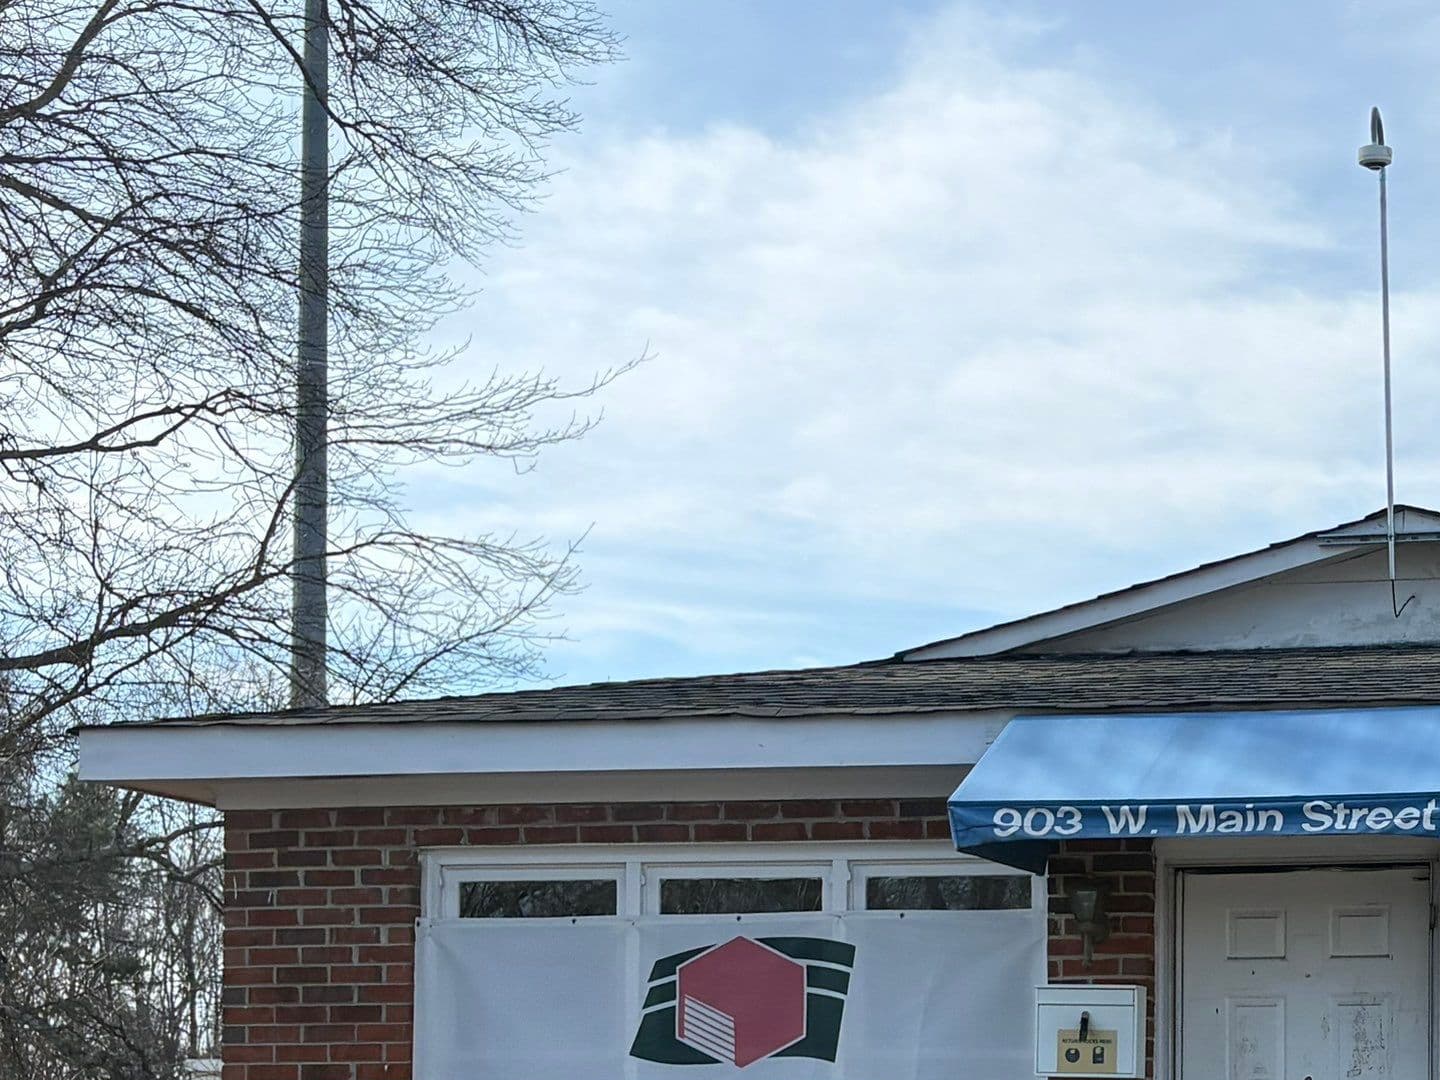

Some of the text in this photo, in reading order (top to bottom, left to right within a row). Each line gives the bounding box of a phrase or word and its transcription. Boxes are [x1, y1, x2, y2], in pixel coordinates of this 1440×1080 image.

[993, 797, 1438, 837] 903 W. Main Street
